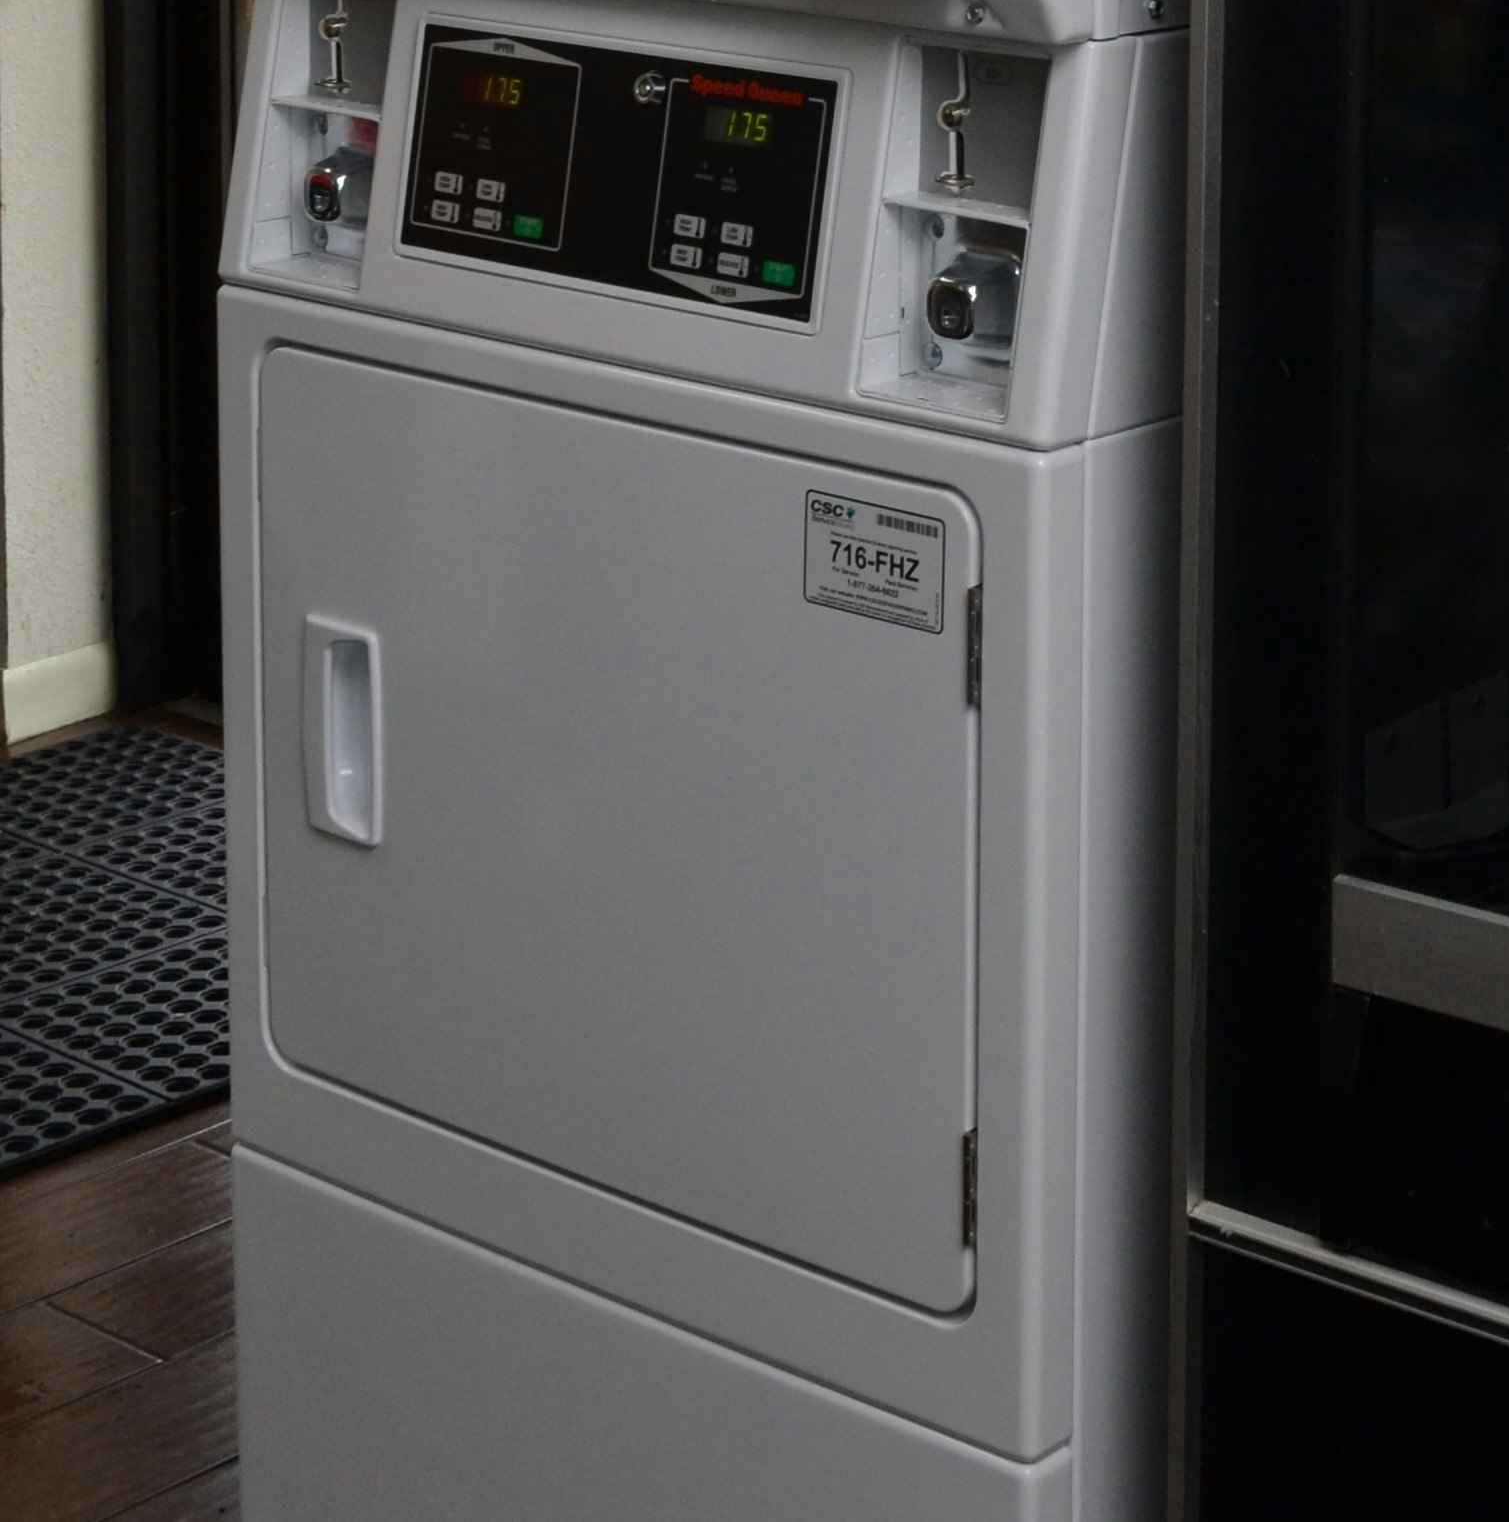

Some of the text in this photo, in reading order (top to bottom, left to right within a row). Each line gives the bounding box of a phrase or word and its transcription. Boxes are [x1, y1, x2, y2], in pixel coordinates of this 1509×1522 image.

[493, 41, 515, 55] UPPER
[484, 76, 522, 106] 175
[690, 73, 804, 108] Speed Queen
[725, 111, 769, 143] 175
[710, 285, 737, 298] LOWER
[810, 499, 845, 518] CSC
[829, 539, 920, 583] 716-FHZ
